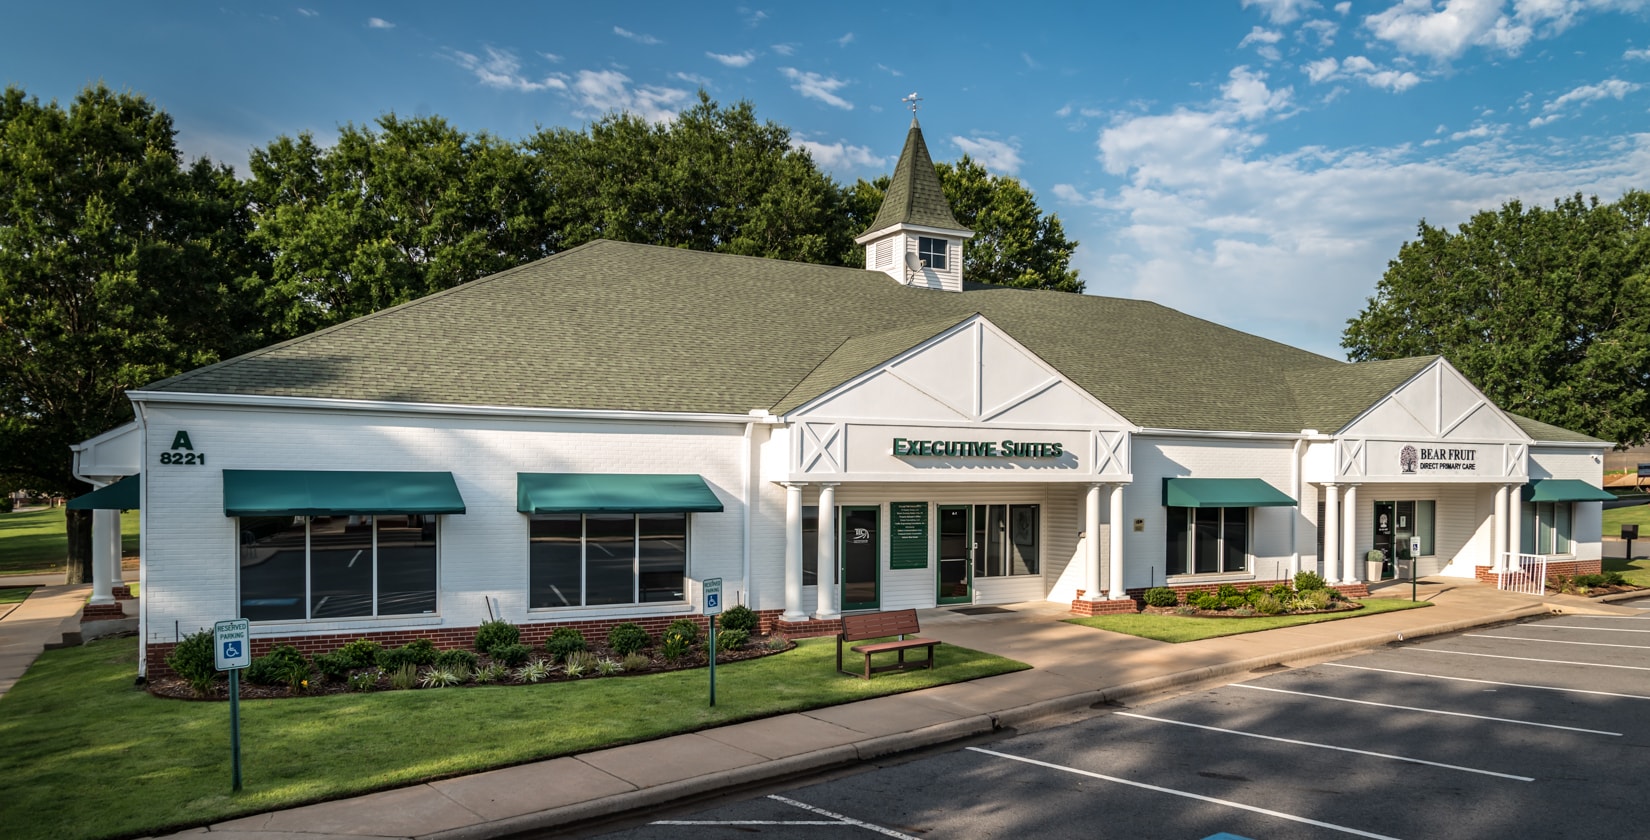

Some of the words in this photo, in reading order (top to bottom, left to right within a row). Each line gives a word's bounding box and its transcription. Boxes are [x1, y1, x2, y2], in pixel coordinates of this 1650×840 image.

[171, 430, 194, 451] A
[893, 438, 997, 457] EXECUTIVE
[1001, 440, 1063, 458] SUITES
[1420, 448, 1447, 460] BEAR
[1448, 449, 1476, 461] FRUIT
[160, 452, 205, 465] 8221
[217, 623, 247, 632] RESERVED
[220, 632, 244, 640] PARKING
